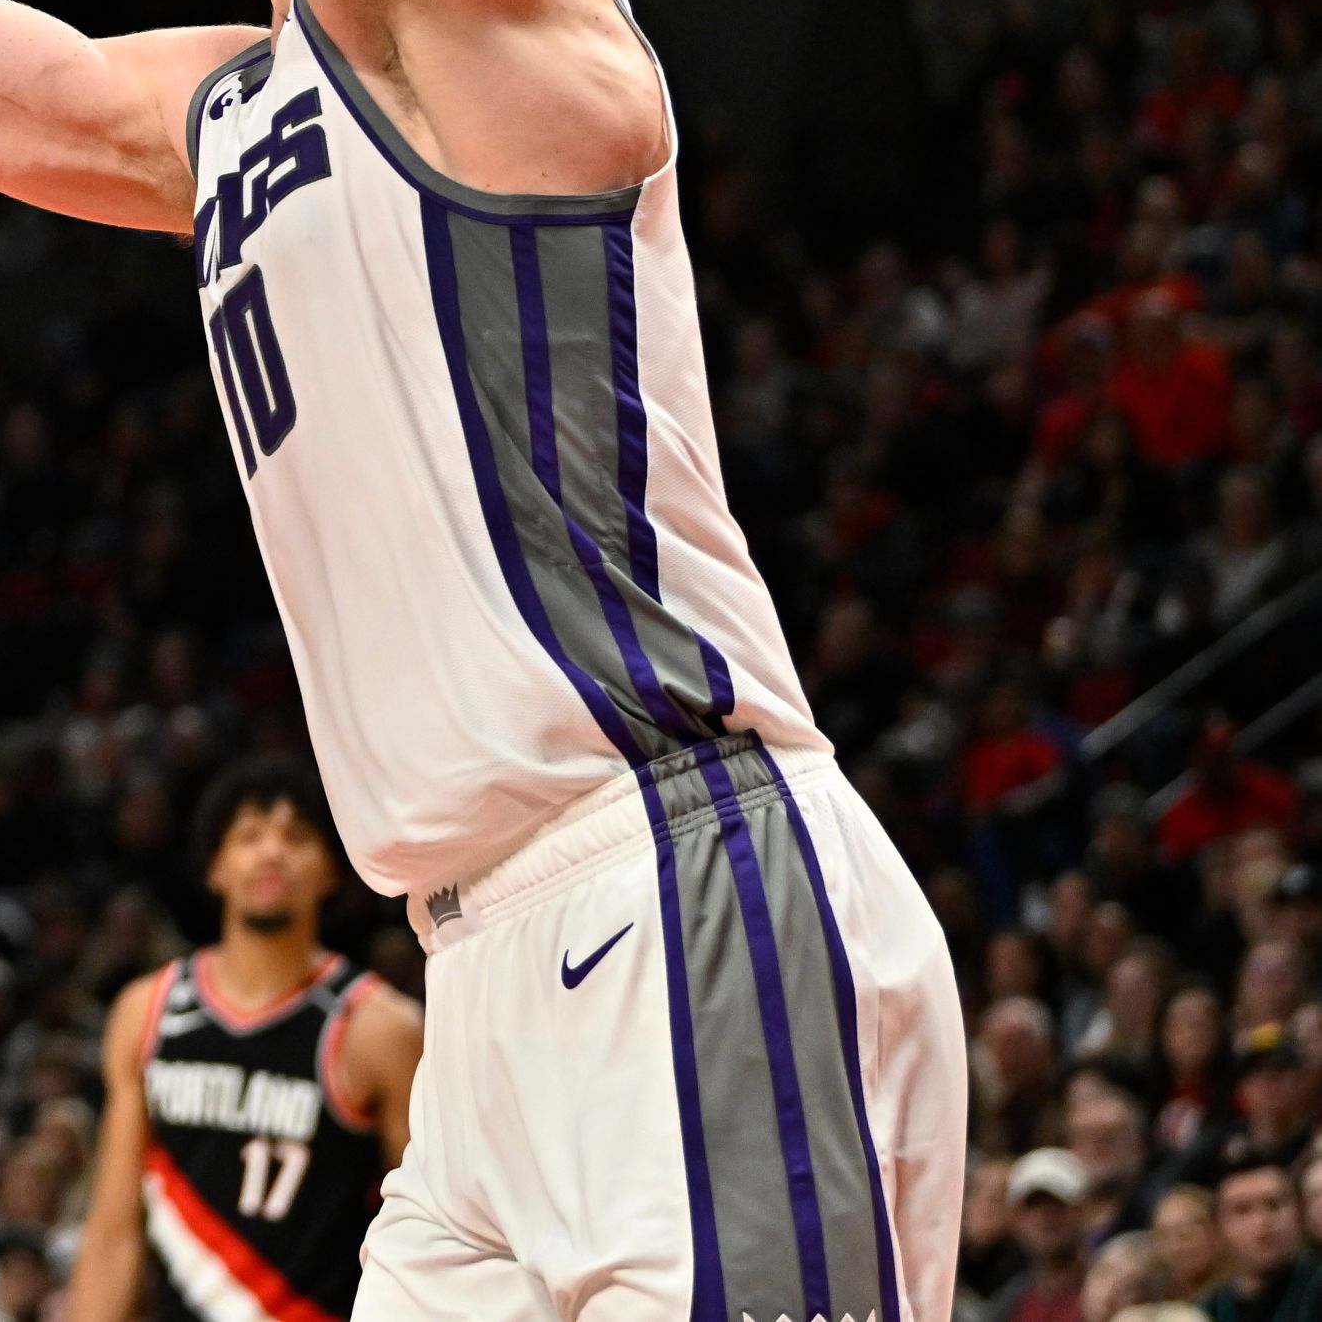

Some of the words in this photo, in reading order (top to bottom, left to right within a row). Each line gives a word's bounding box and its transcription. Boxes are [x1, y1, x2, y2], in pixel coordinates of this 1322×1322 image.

[210, 263, 297, 481] 10
[147, 1060, 322, 1140] PORTLAND
[237, 1137, 312, 1222] 17
